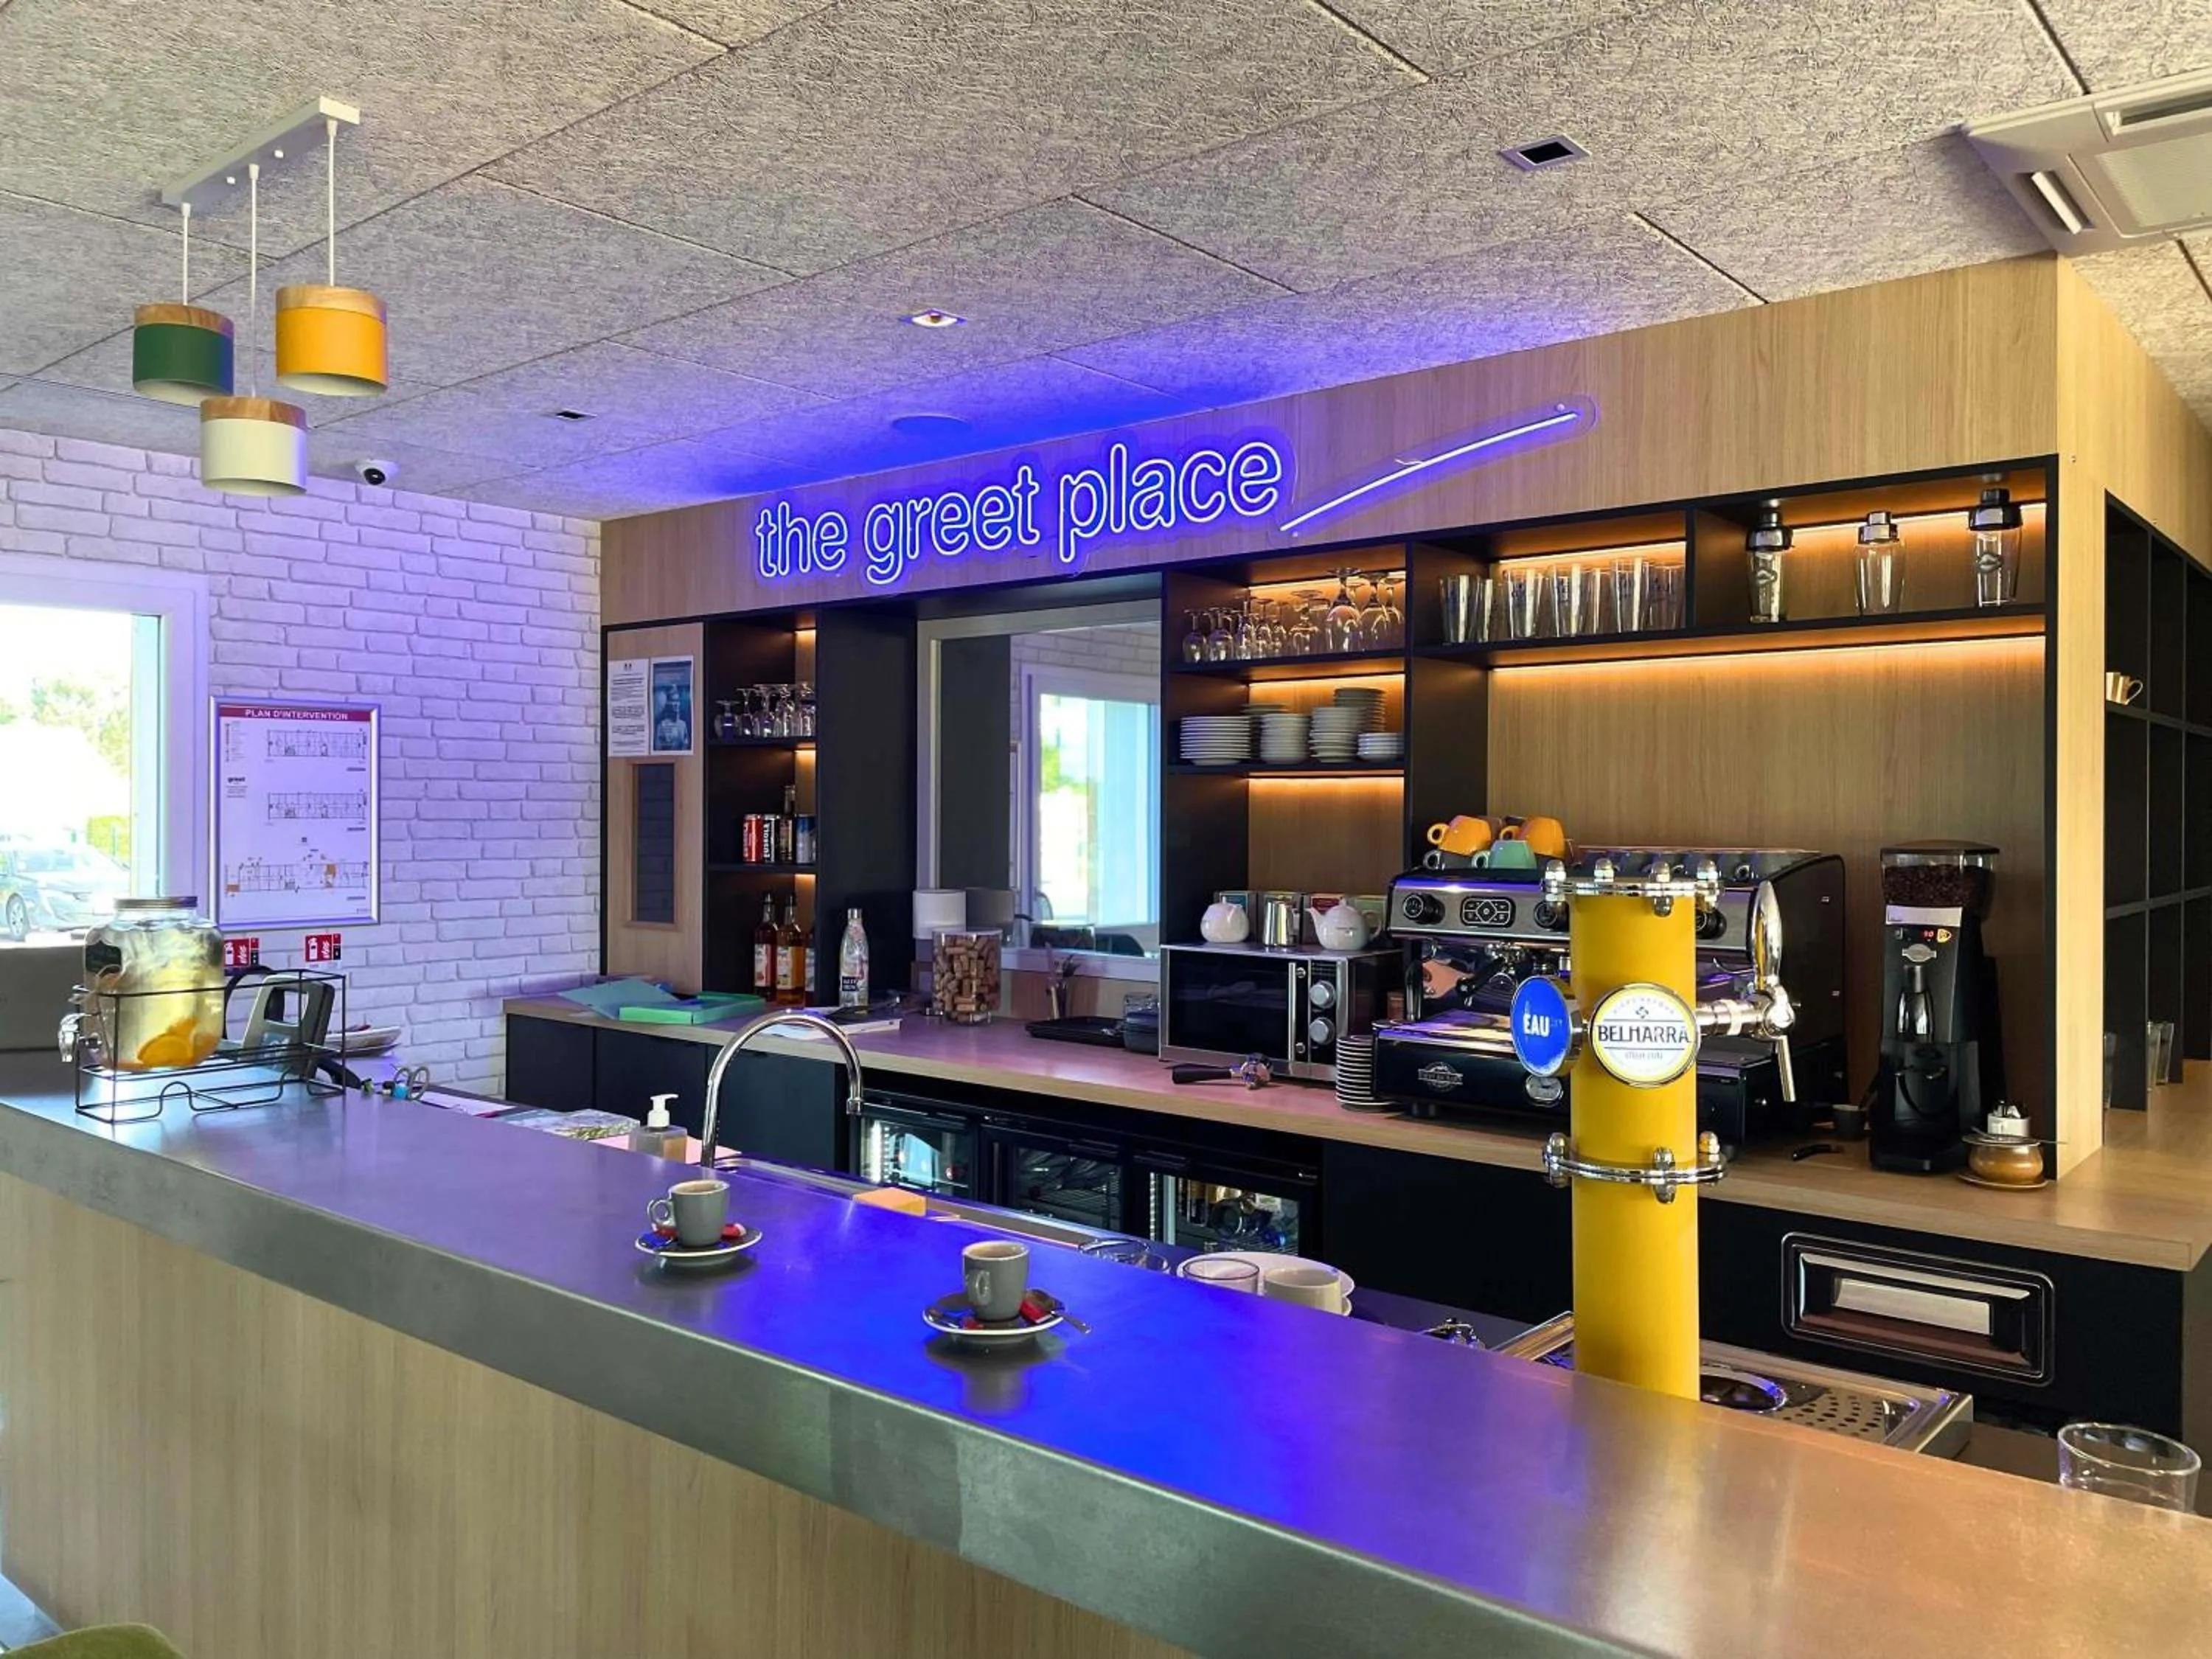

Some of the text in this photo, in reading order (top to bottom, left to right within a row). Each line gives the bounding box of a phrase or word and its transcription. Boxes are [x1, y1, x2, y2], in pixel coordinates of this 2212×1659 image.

[755, 442, 1283, 585] the greet place
[245, 709, 348, 720] PLAN D'INTERVENTION
[1523, 1013, 1550, 1037] EAU
[1597, 1024, 1689, 1043] BELHARRA
